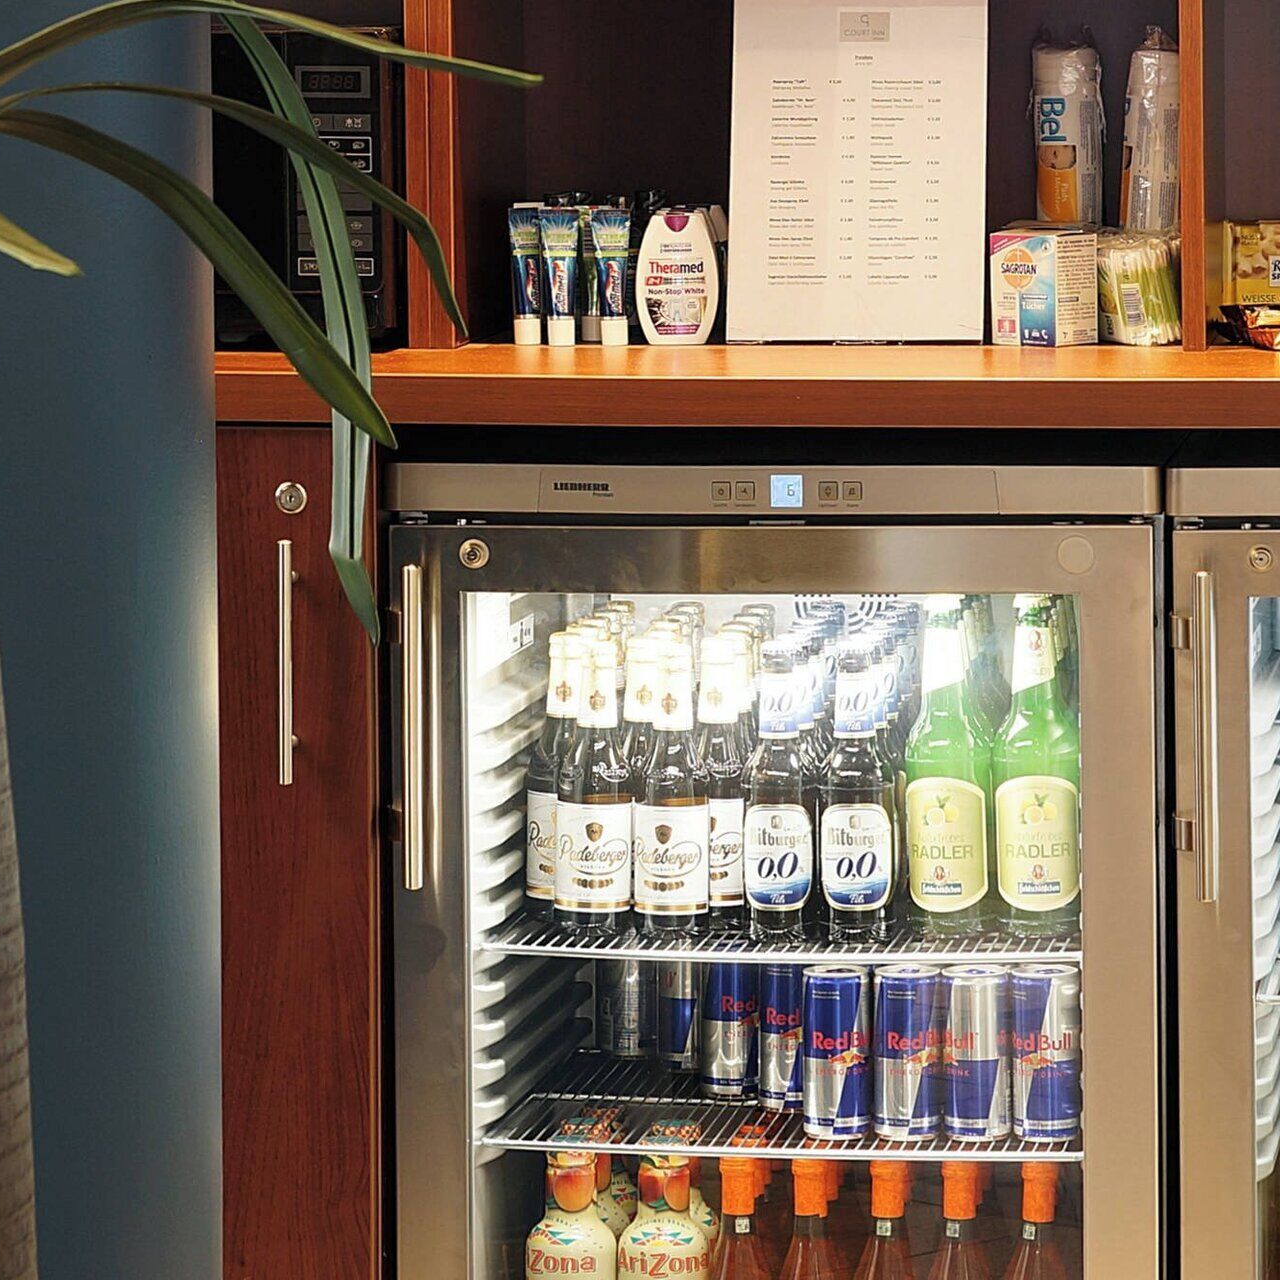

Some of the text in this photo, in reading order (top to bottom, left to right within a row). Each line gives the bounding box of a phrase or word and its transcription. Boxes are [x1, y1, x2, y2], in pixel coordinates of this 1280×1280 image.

[1040, 97, 1067, 142] Bel
[649, 261, 704, 273] Theramed
[1001, 262, 1037, 276] SAGROTAN
[648, 287, 705, 297] Non-Stop White
[1242, 294, 1277, 303] WEISSE
[1021, 300, 1046, 311] Tücher
[553, 482, 610, 492] LIEBHERR
[750, 827, 810, 848] Bitburger
[827, 827, 885, 848] Bitburger
[559, 832, 628, 863] Radeberger
[632, 835, 700, 867] Radeberger
[913, 846, 973, 859] RADLER
[1006, 843, 1070, 859] RADLER
[758, 851, 799, 880] 0,0
[836, 851, 877, 880] 0,0
[722, 996, 756, 1012] Red
[766, 1008, 799, 1025] Red
[813, 1031, 847, 1050] Red
[887, 1032, 922, 1050] Red
[1039, 1032, 1072, 1051] Bull
[619, 1247, 709, 1278] AriZona
